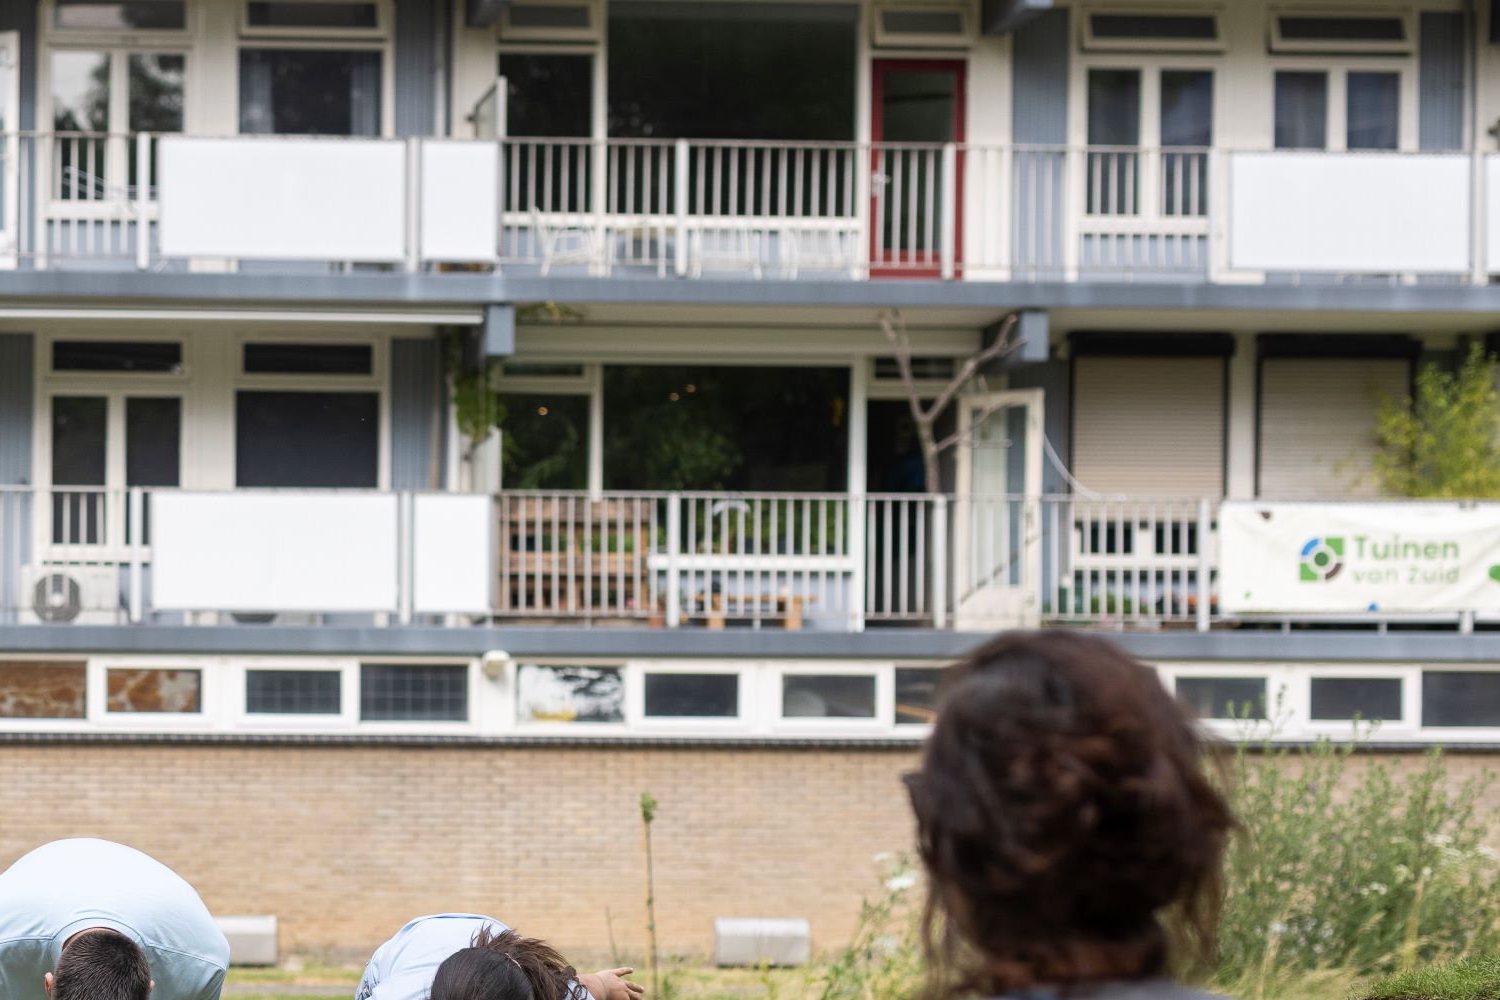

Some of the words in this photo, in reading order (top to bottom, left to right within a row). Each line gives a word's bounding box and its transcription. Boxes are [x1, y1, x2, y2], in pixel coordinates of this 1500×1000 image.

[1353, 534, 1459, 560] Tuinen
[1353, 569, 1399, 584] van
[1407, 566, 1460, 584] Zuid
